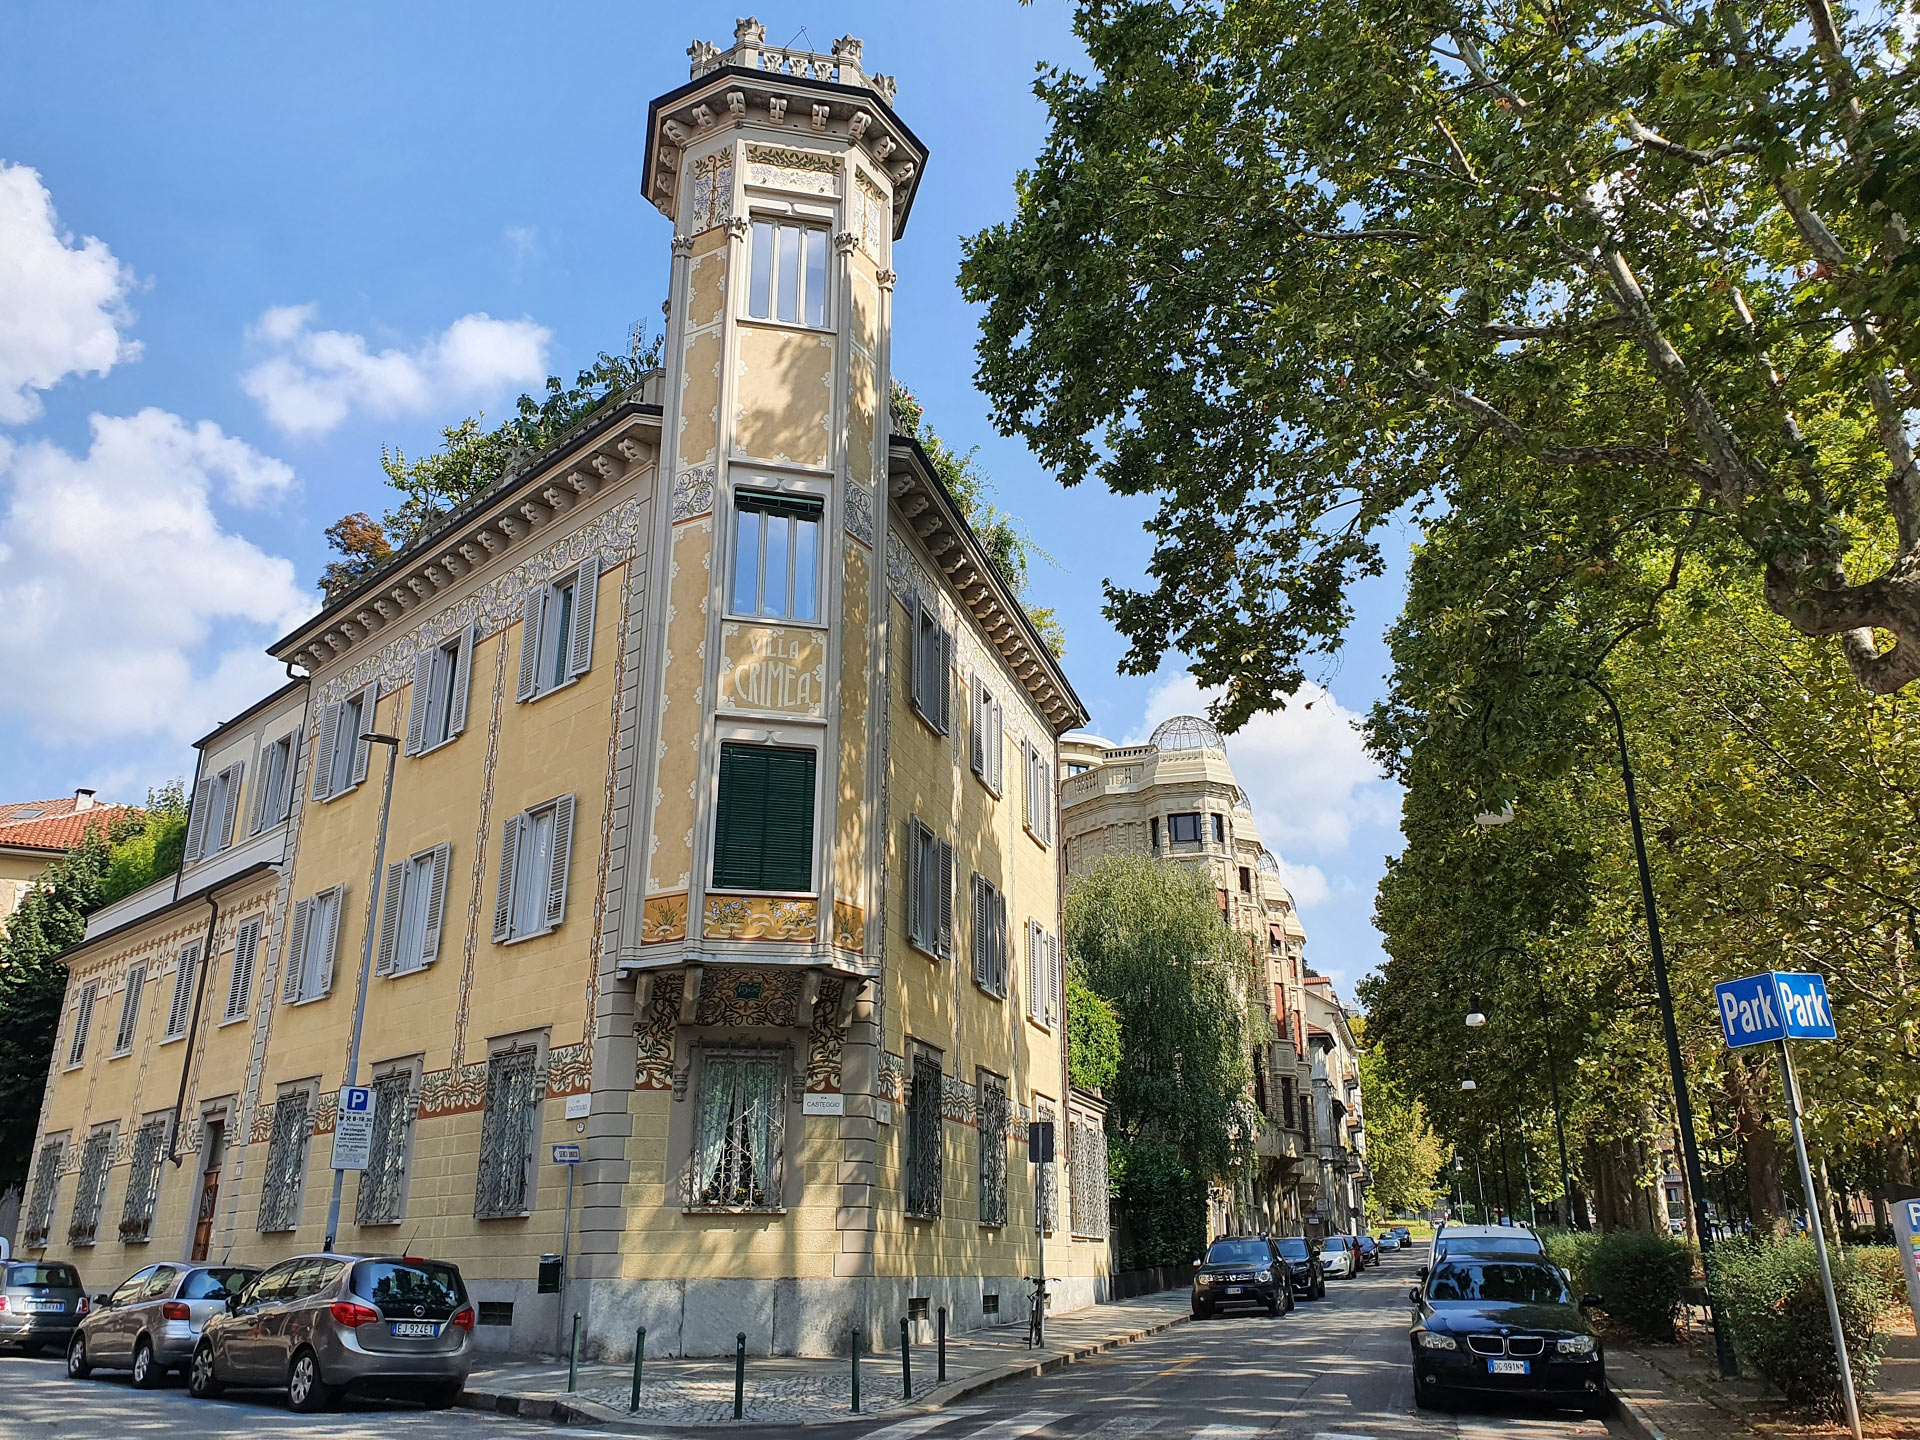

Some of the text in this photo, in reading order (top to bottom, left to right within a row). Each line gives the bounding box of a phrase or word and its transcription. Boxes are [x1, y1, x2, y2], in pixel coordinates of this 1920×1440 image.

[749, 635, 800, 660] VILLA
[734, 660, 812, 708] CRIMEA
[1721, 985, 1779, 1036] Park
[1779, 981, 1831, 1028] Park
[351, 1092, 364, 1108] P
